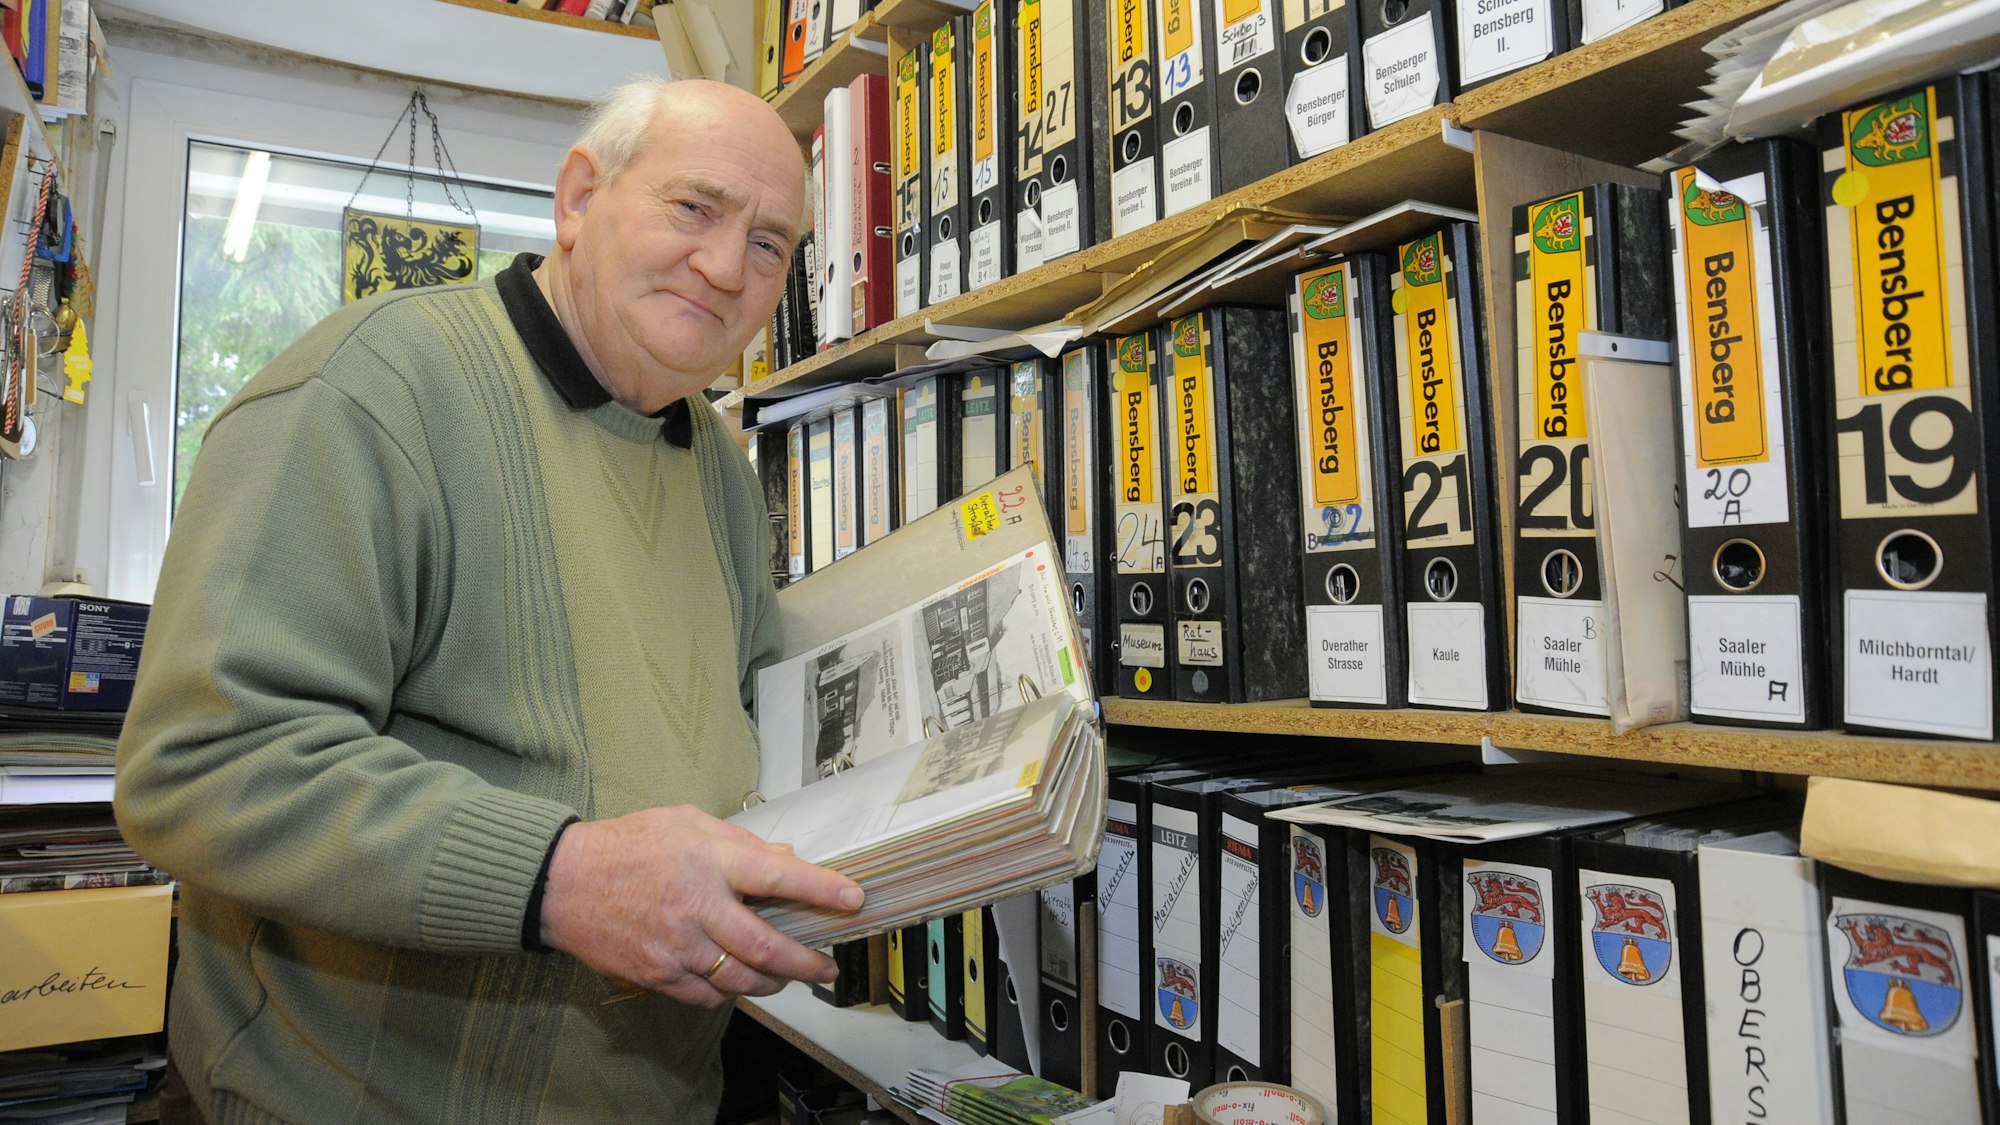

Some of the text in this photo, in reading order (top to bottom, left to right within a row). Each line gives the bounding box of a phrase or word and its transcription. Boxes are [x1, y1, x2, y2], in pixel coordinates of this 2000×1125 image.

[1122, 0, 1136, 63] sberg
[1474, 7, 1533, 39] Bensberg
[1497, 37, 1510, 53] II.
[1027, 19, 1040, 113] Bensberg
[1165, 52, 1191, 96] 13
[1375, 50, 1428, 81] Bensberger
[977, 52, 987, 142] Bensberg
[1113, 58, 1151, 126] 13
[1384, 72, 1421, 95] Schulen
[938, 68, 946, 155] Bensberg
[1046, 81, 1071, 135] 27
[1297, 89, 1346, 115] Bensberger
[1307, 108, 1336, 127] Bürger
[903, 94, 912, 175] Bensberg
[1018, 117, 1042, 171] 14
[976, 158, 992, 188] 15
[1169, 157, 1203, 179] Bensberger
[934, 166, 949, 207] 15
[1118, 185, 1147, 206] Bensberger
[1170, 177, 1192, 193] Vereine
[1047, 207, 1073, 224] Bensberger
[1120, 203, 1138, 218] Vereine
[1048, 223, 1066, 236] Vereine
[1875, 194, 1923, 391] Bensberg
[1705, 252, 1743, 424] Bensberg
[1544, 278, 1577, 439] Bensberg
[1417, 308, 1442, 454] Bensberg
[1317, 341, 1344, 475] Bensberg
[1127, 392, 1142, 502] Bensberg
[1182, 376, 1199, 494] Bensberg
[1070, 408, 1084, 511] Bensberg
[1837, 397, 1978, 505] 19
[870, 446, 880, 525] Bensberg
[998, 485, 1025, 513] 22
[1403, 454, 1472, 541] 21
[1704, 468, 1751, 500] 20
[1722, 499, 1741, 524] A
[1118, 513, 1163, 572] 24
[1171, 498, 1221, 565] 23
[79, 604, 110, 613] SONY
[1122, 634, 1164, 653] Museum
[1189, 643, 1218, 661] haus
[1322, 638, 1368, 655] Overather
[1433, 647, 1460, 662] Kaule
[1543, 636, 1582, 653] Saaler
[1719, 638, 1767, 654] Saaler
[1858, 638, 1976, 664] Milchborntal/
[1327, 656, 1363, 671] Strasse
[1543, 657, 1581, 674] Mühle
[1719, 660, 1766, 678] Mühle
[1891, 665, 1939, 685] Hardt
[1768, 680, 1788, 702] A
[1161, 830, 1187, 848] LEITZ
[1043, 890, 1072, 911] Overath
[1153, 849, 1199, 929] Marialinden
[1061, 912, 1069, 926] 2
[1221, 870, 1258, 949] Heiligenhaus
[1734, 928, 1769, 1125] OBERS
[1212, 1102, 1255, 1117] fix-o-moll
